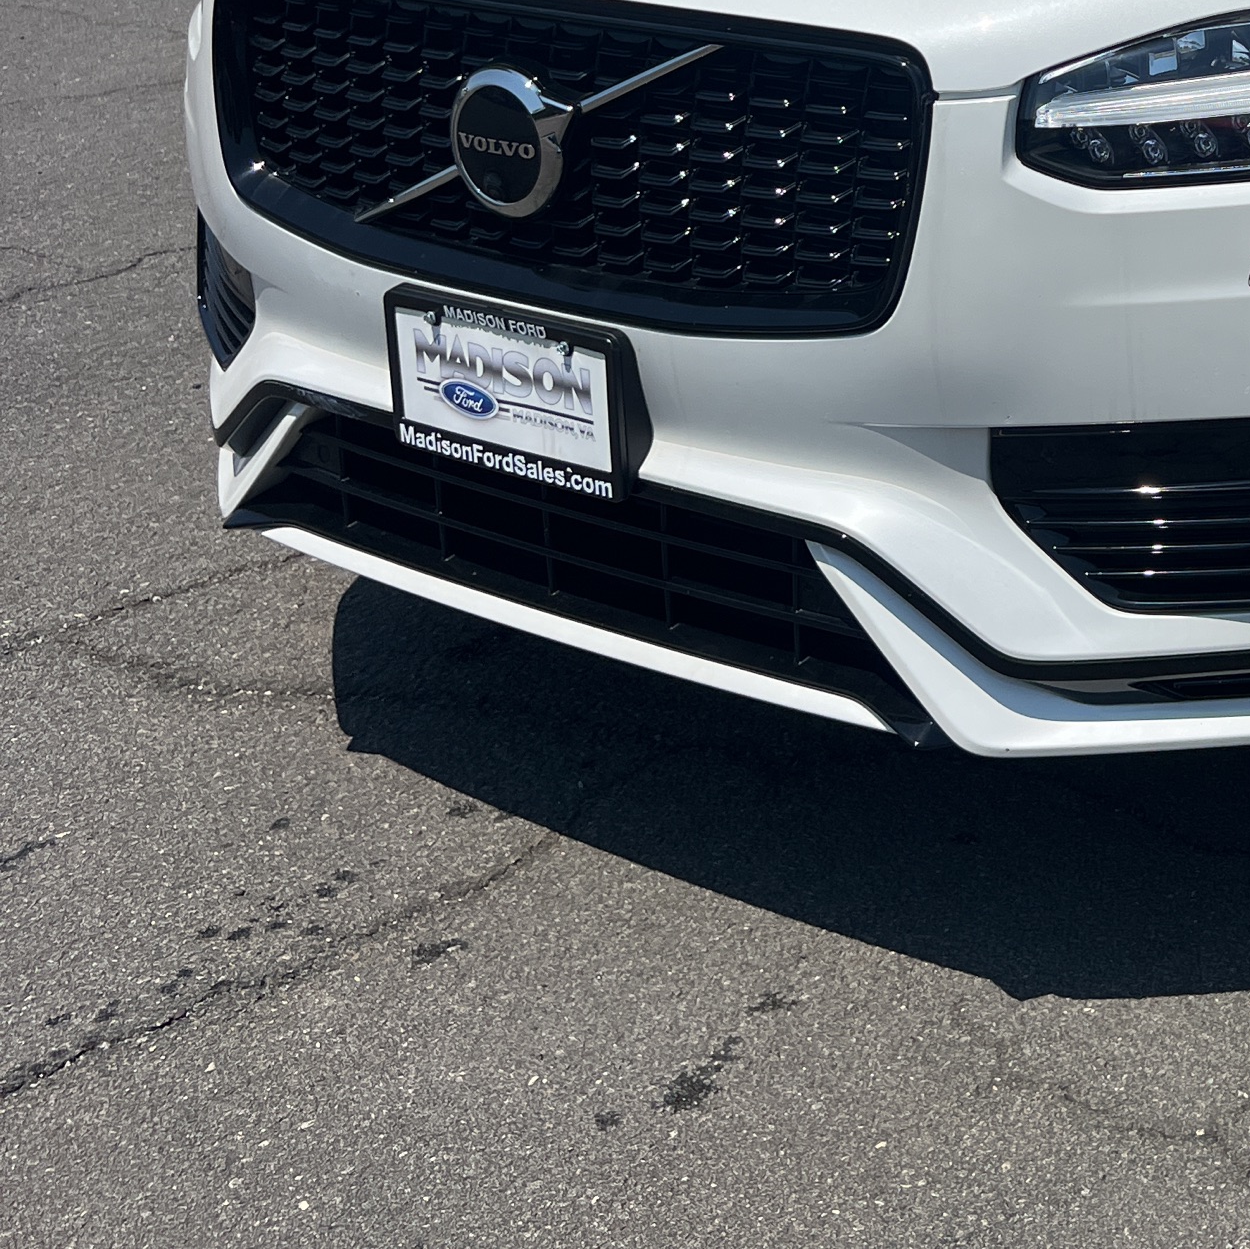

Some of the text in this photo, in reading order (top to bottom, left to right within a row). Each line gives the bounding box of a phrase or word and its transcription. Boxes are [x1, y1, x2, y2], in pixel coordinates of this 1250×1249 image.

[458, 131, 536, 159] VOLVO
[443, 305, 547, 339] MADISON FORD
[413, 328, 594, 416] MADISON
[452, 386, 484, 413] Ford
[399, 423, 613, 499] MadisonFordSales.com
